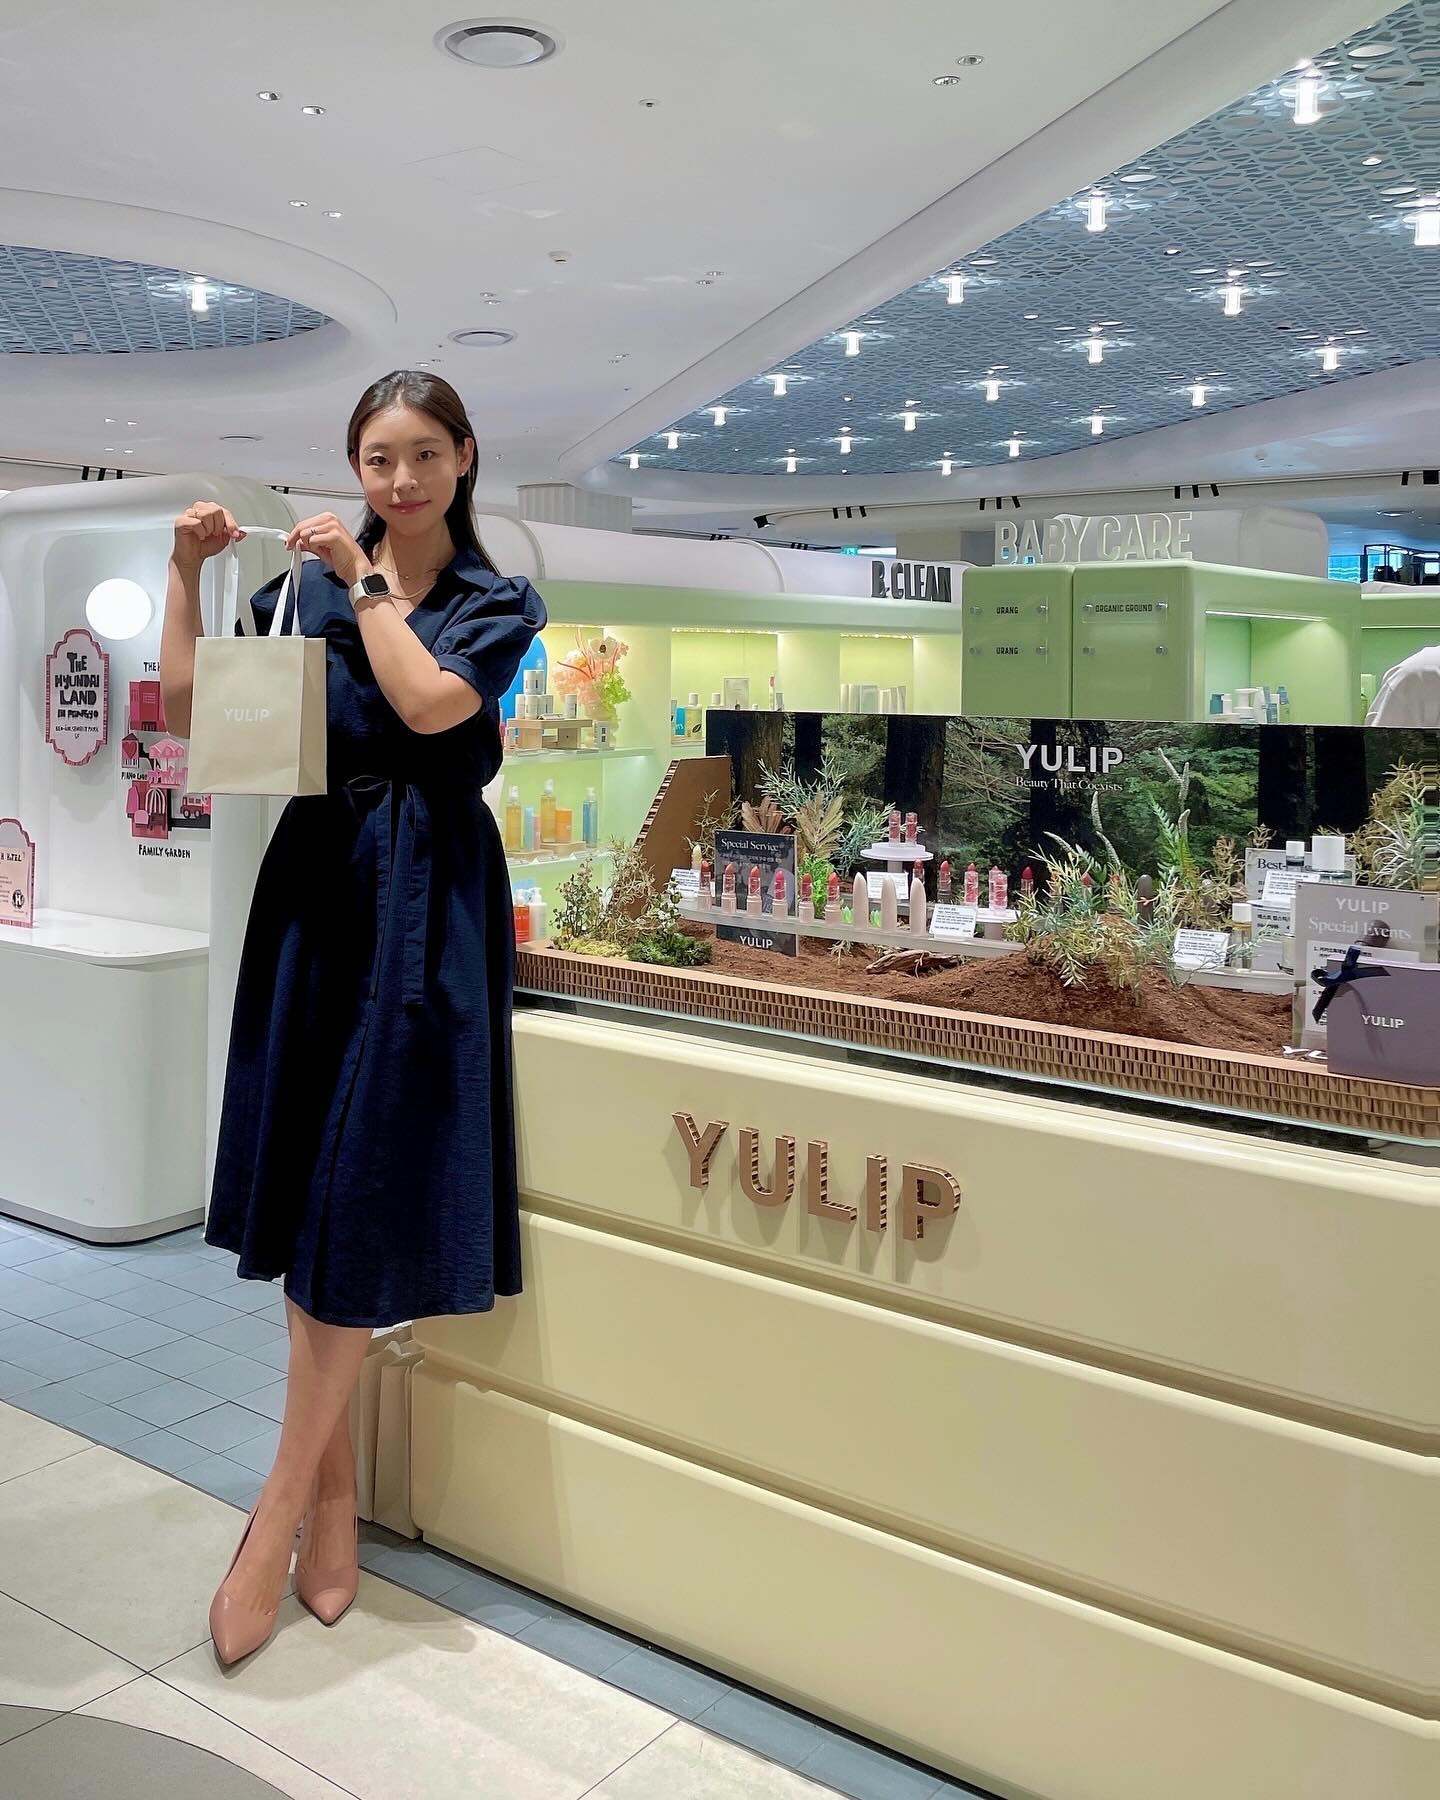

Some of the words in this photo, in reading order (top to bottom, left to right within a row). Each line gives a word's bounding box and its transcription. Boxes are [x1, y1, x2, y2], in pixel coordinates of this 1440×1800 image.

[994, 517, 1092, 565] BABY
[1097, 511, 1193, 561] CARE
[1095, 604, 1124, 613] ORGANIC
[1125, 604, 1153, 612] GROUND
[66, 652, 87, 673] THE
[143, 661, 156, 673] THE
[55, 674, 100, 689] HYUNDAI
[60, 690, 97, 705] LAND
[223, 708, 271, 722] YULIP
[1015, 744, 1124, 774] YULIP
[1015, 776, 1049, 791] Beauty
[1050, 778, 1076, 790] That
[1078, 780, 1123, 791] Coexists
[138, 844, 164, 857] FAMILY
[164, 847, 191, 859] GARDEN
[721, 838, 749, 850] Special
[750, 840, 780, 852] Service
[1336, 897, 1390, 914] YULIP
[1308, 917, 1360, 934] Special
[1363, 922, 1412, 939] Events
[740, 935, 773, 948] YULIP
[1362, 1014, 1405, 1029] YULIP
[672, 1112, 961, 1241] YULIP
